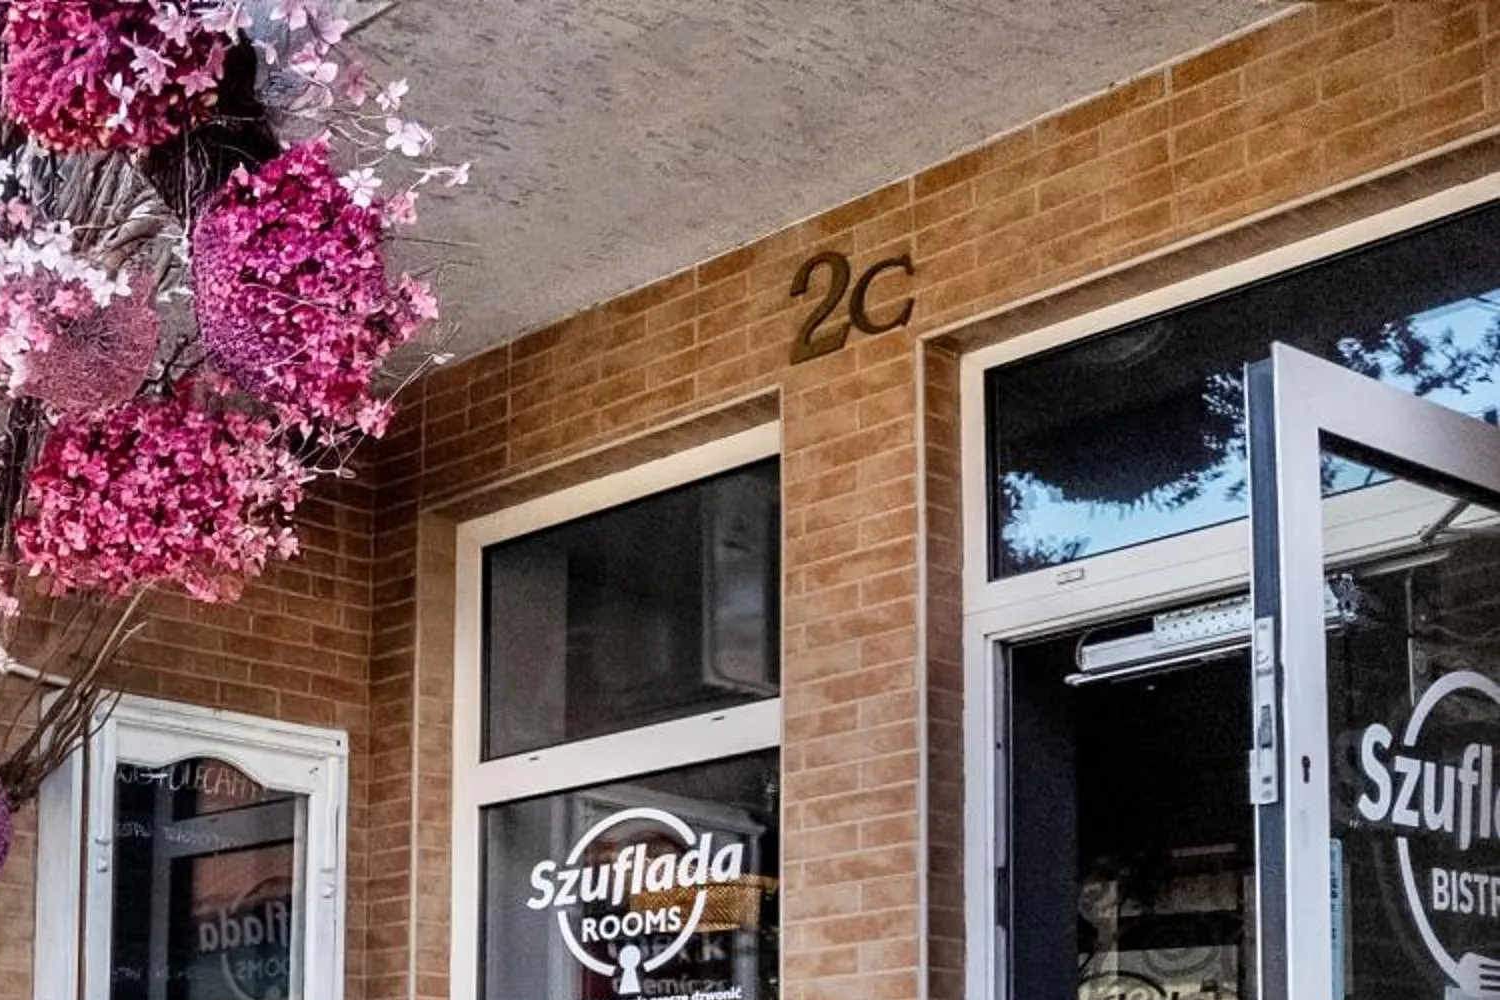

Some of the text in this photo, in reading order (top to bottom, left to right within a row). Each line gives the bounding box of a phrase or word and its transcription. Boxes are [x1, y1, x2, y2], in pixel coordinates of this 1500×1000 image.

[1358, 722, 1500, 851] Szufl
[526, 832, 745, 910] Szuflada
[581, 905, 682, 942] ROOMS
